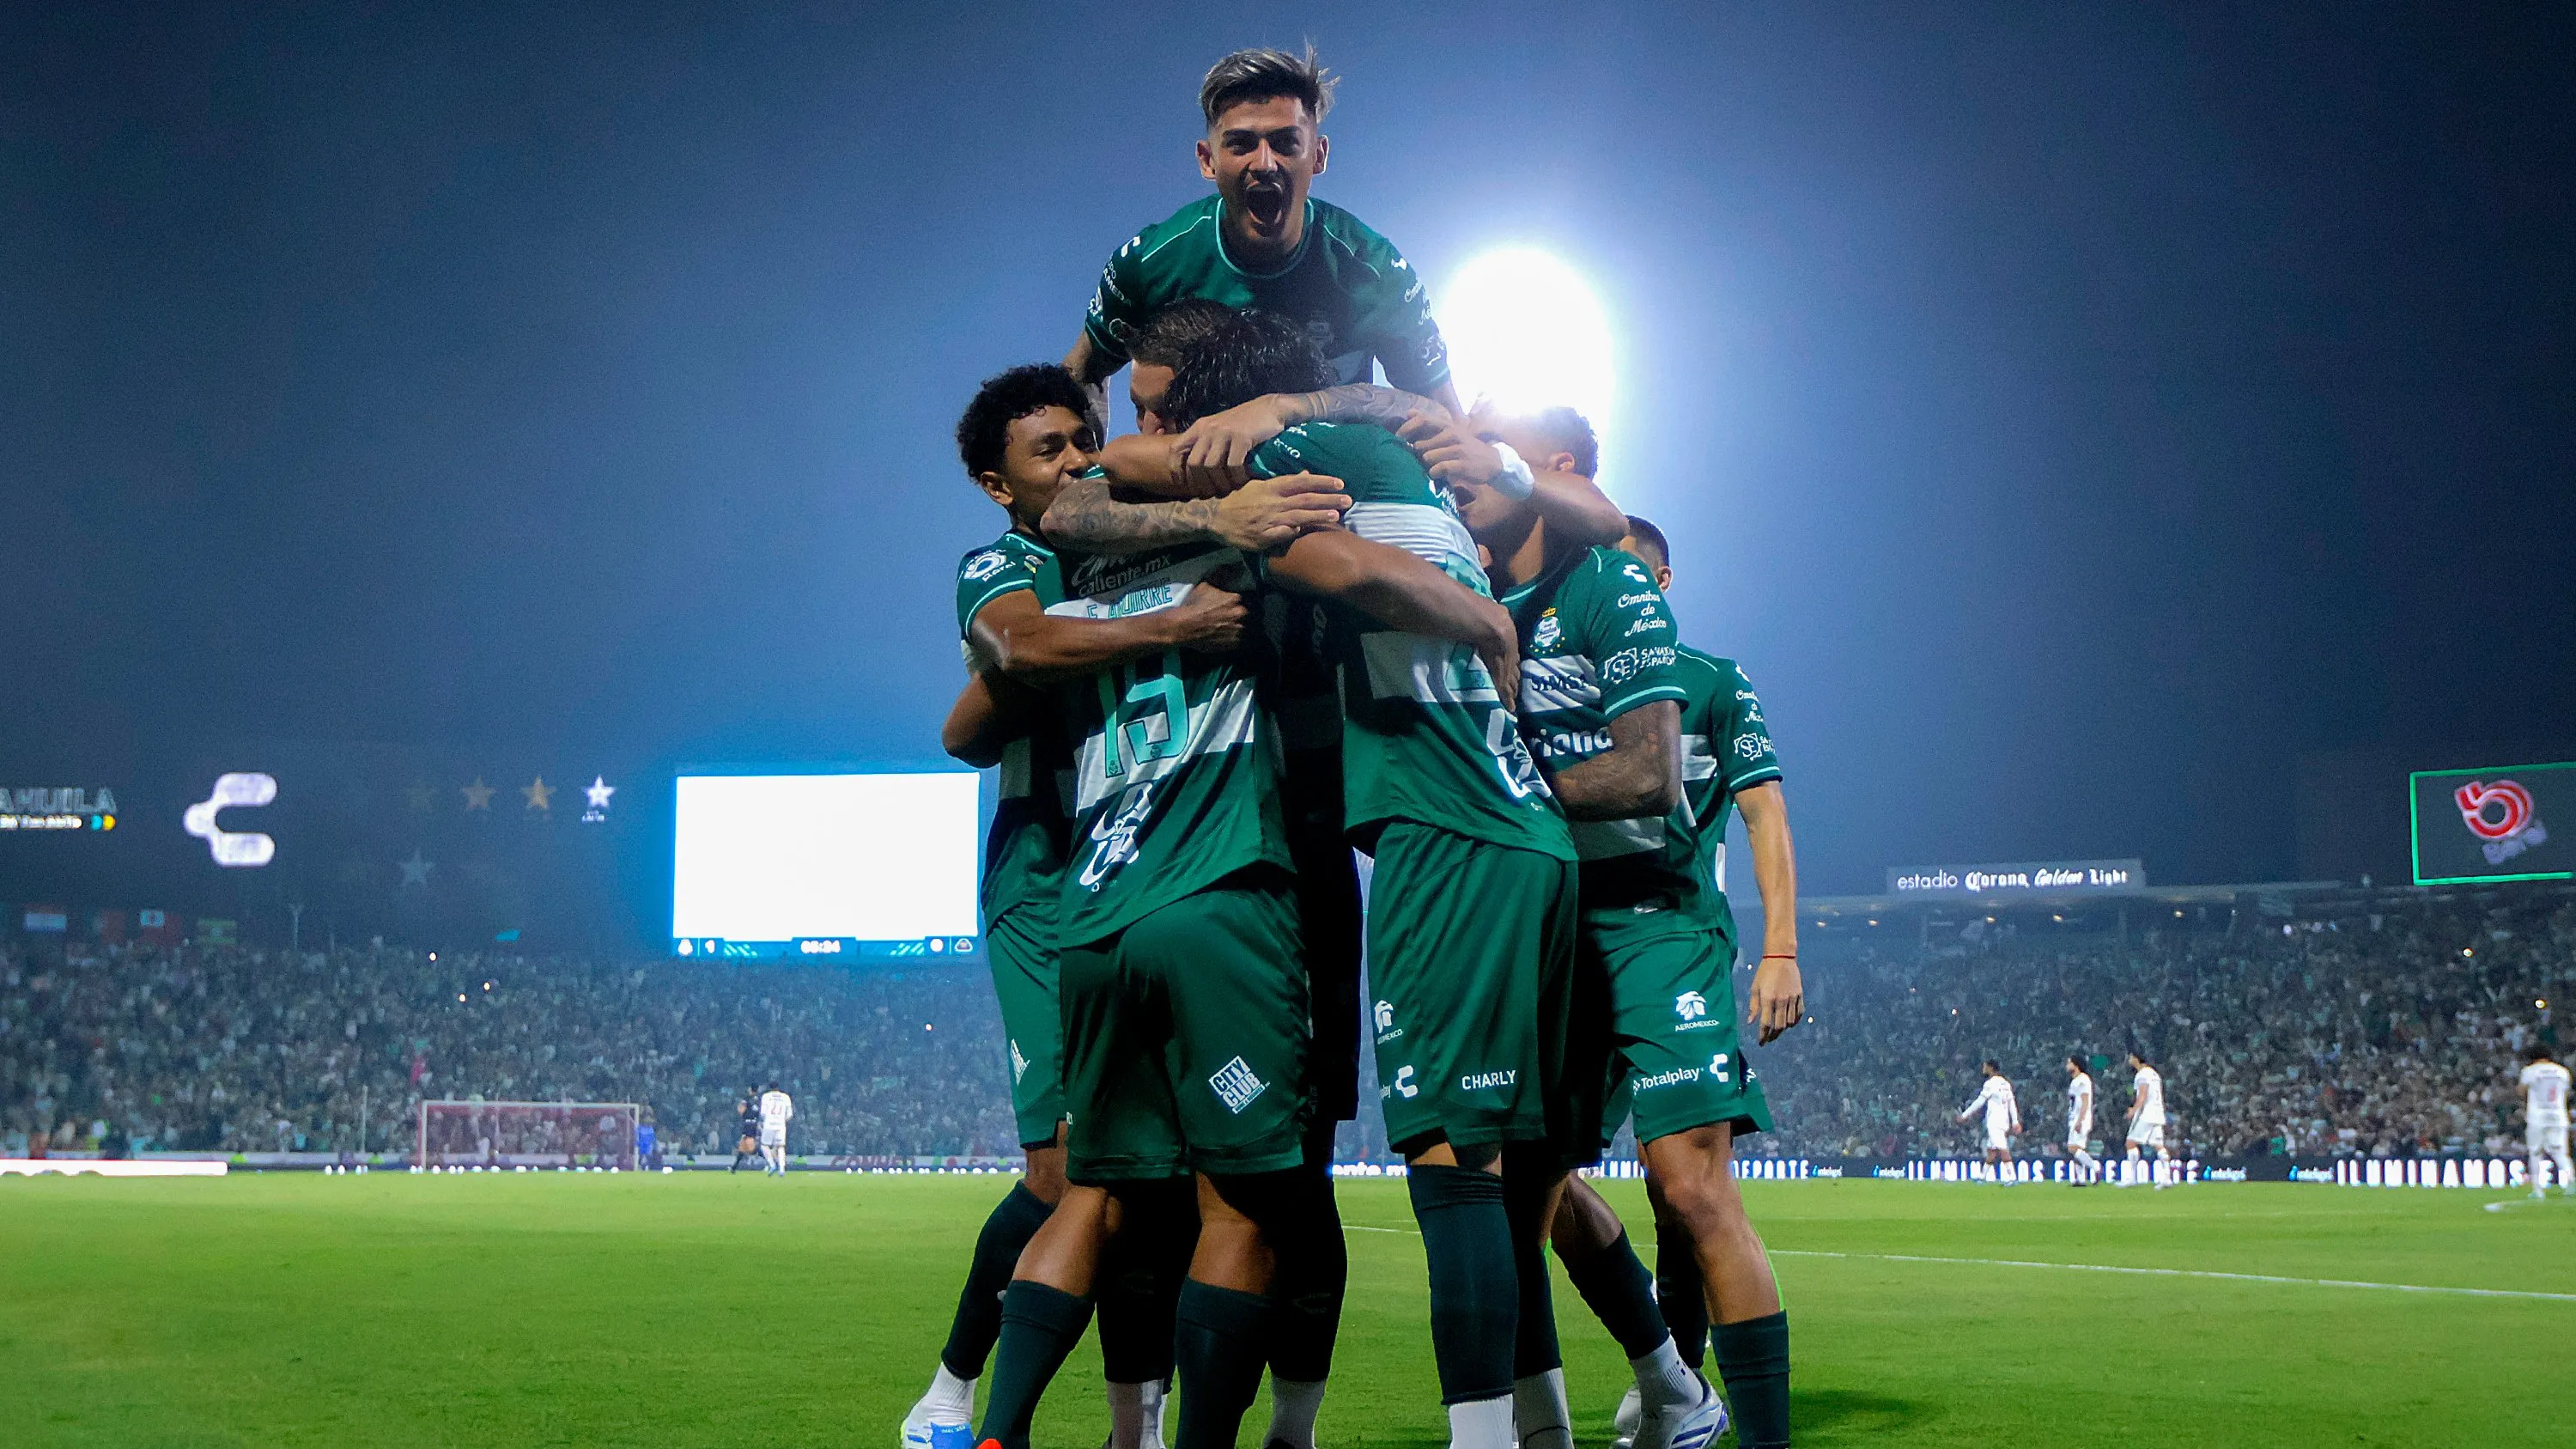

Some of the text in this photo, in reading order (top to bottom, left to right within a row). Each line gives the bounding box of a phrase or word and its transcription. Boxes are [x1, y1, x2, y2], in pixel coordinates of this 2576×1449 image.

[1078, 554, 1171, 597] caliente.mx
[1618, 590, 1661, 608] Omnibus
[1641, 603, 1656, 616] de
[1625, 618, 1668, 636] México
[1897, 868, 2128, 892] estadio Corona Golden Light
[1675, 1020, 1718, 1032] AEROMEXICO
[1212, 1058, 1247, 1093] CITY
[1461, 1070, 1516, 1090] CHARLY
[1641, 1068, 1700, 1090] Totalplay
[1223, 1072, 1261, 1107] CLUB
[2336, 1160, 2529, 1189] ILUMINAMOS
